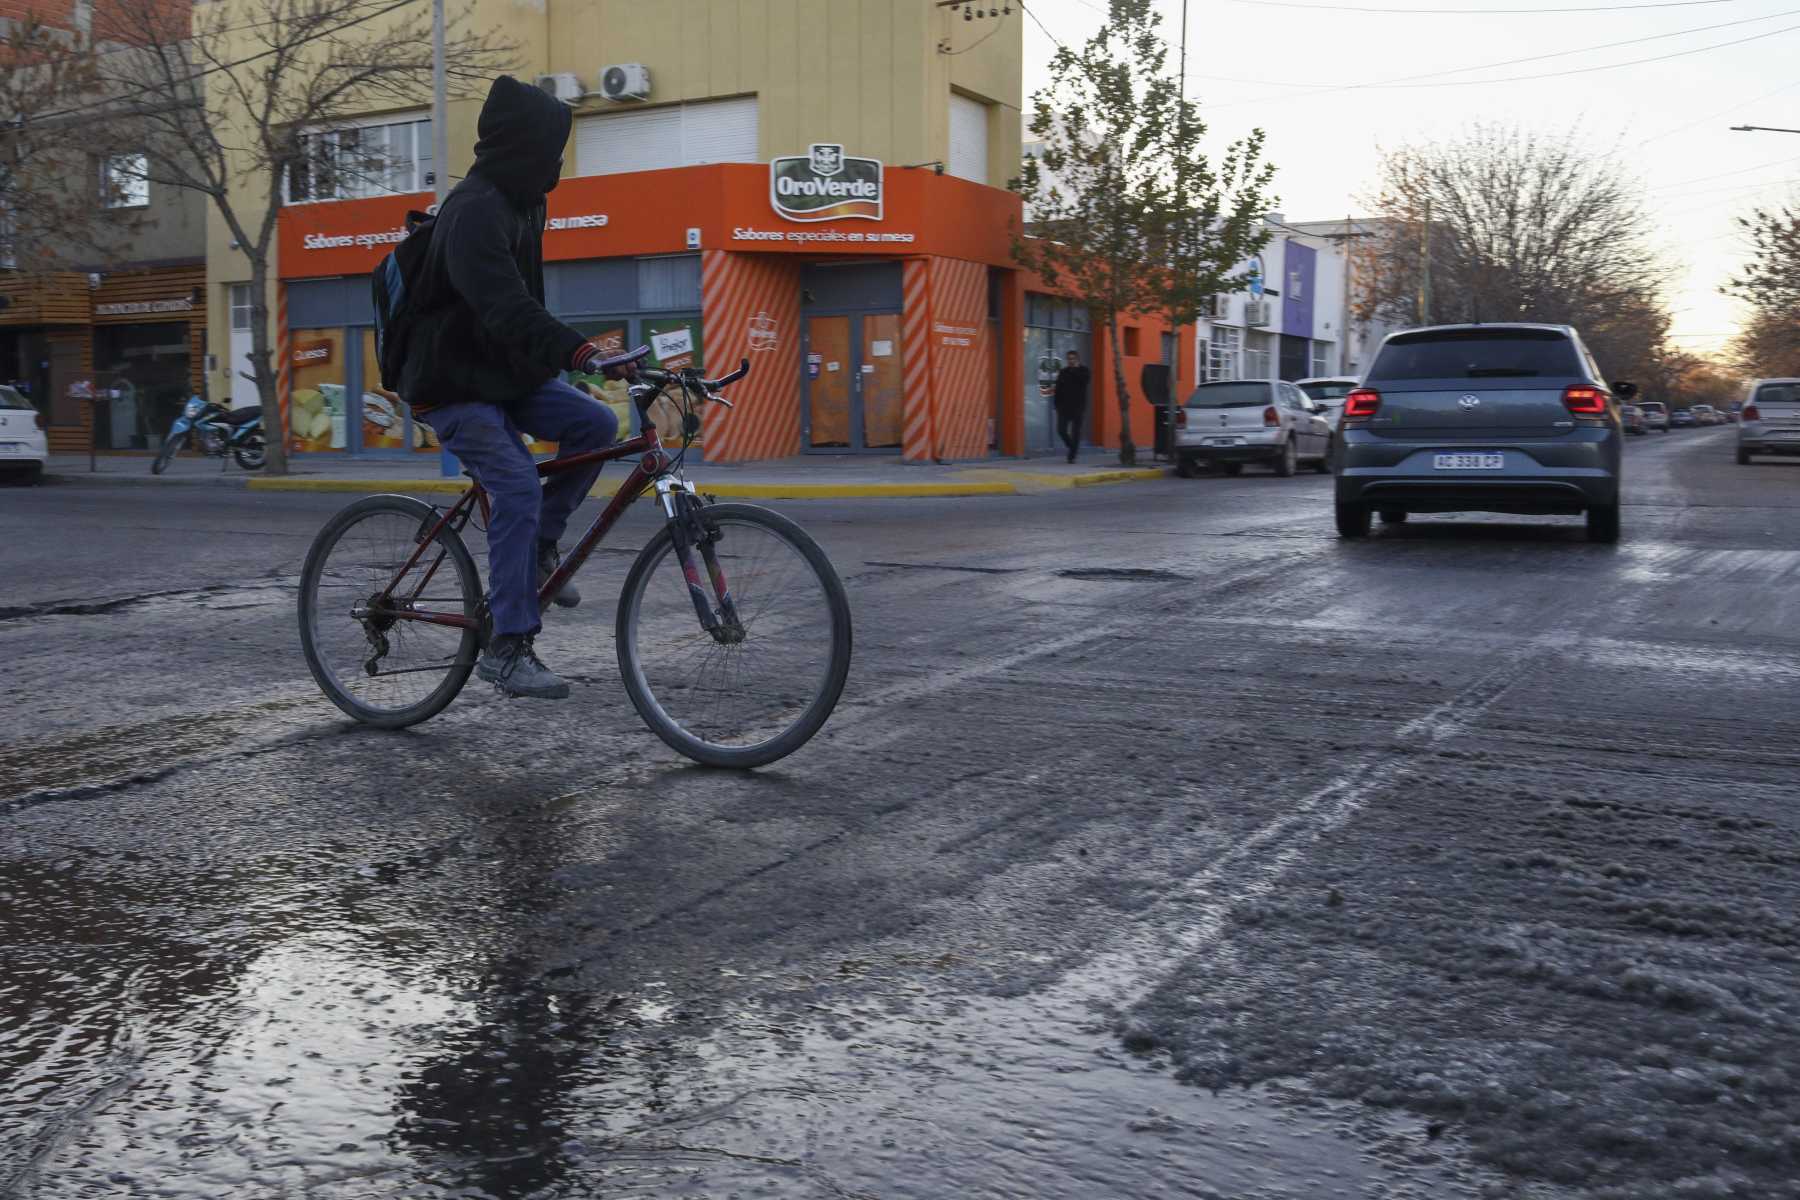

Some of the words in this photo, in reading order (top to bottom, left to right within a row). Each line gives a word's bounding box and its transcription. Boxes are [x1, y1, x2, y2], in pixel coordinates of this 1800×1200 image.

[777, 176, 877, 197] OroVerde
[303, 233, 354, 249] Sabores
[567, 214, 608, 229] mesa
[732, 227, 784, 240] Sabores
[786, 229, 846, 244] especiales
[848, 232, 864, 242] en
[865, 233, 880, 242] su
[881, 233, 914, 242] mesa
